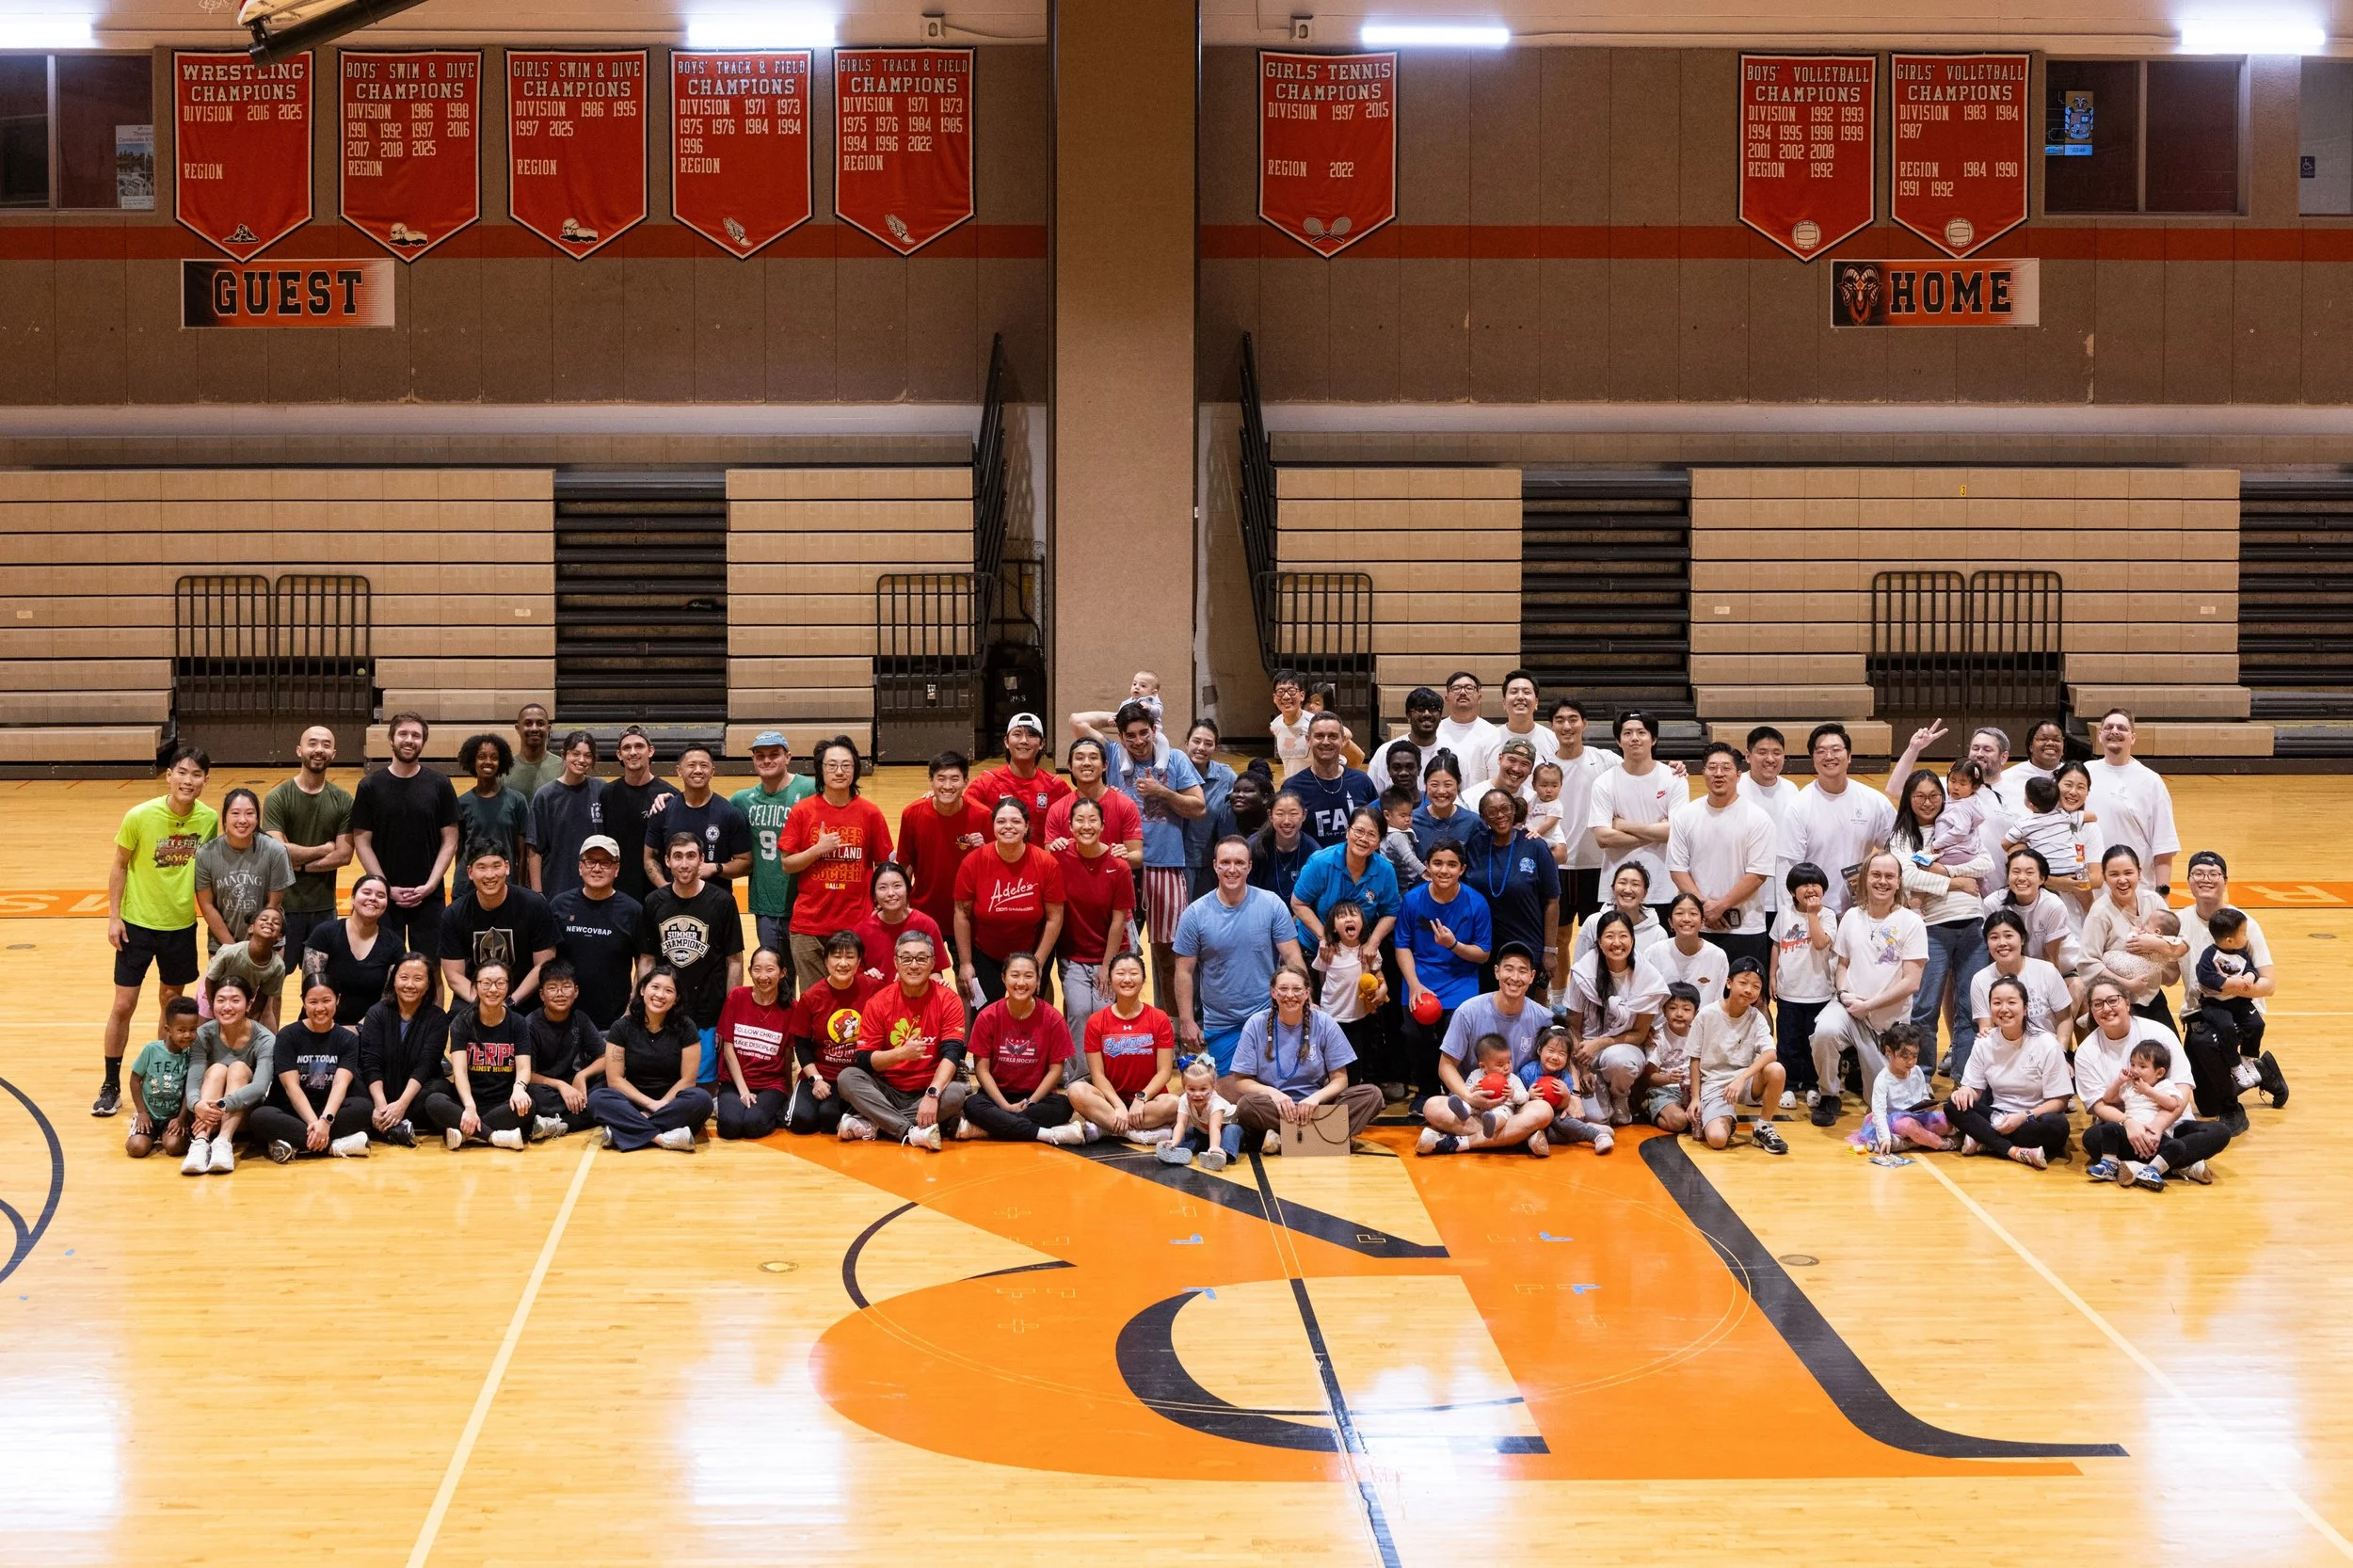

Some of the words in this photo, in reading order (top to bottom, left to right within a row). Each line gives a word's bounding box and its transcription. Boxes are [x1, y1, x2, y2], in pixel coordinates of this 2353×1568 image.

[389, 64, 420, 79] SWIM
[429, 63, 436, 78] &
[447, 63, 474, 78] DIVE
[560, 62, 590, 78] SWIM
[597, 63, 604, 78] &
[612, 61, 640, 78] DIVE
[717, 62, 751, 74] TRACK
[759, 61, 766, 74] &
[775, 61, 805, 74] FIELD
[883, 60, 916, 72] TRACK
[924, 59, 930, 71] &
[938, 59, 967, 72] FIELD
[1328, 63, 1391, 80] TENNIS
[1946, 65, 2023, 81] VOLLEYBALL
[1794, 67, 1869, 82] VOLLEYBALL
[192, 84, 296, 102] CHAMPIONS
[357, 83, 464, 99] CHAMPIONS
[524, 81, 631, 97] CHAMPIONS
[688, 79, 795, 95] CHAMPIONS
[851, 77, 957, 93] CHAMPIONS
[1276, 83, 1381, 101] CHAMPIONS
[1908, 85, 2013, 101] CHAMPIONS
[1755, 86, 1860, 102] CHAMPIONS
[184, 106, 233, 121] DIVISION
[248, 105, 269, 121] 2016
[278, 104, 302, 120] 2025
[348, 103, 391, 119] DIVISION
[411, 103, 433, 118] 1986
[447, 103, 469, 118] 1988
[516, 101, 566, 117] DIVISION
[581, 102, 604, 117] 1986
[613, 101, 636, 117] 1995
[680, 99, 730, 115] DIVISION
[745, 99, 765, 115] 1971
[777, 99, 800, 114] 1973
[843, 97, 893, 112] DIVISION
[908, 97, 928, 112] 1971
[941, 98, 962, 113] 1973
[1268, 102, 1317, 120] DIVISION
[1332, 105, 1355, 120] 1997
[1366, 102, 1389, 118] 2015
[1900, 105, 1949, 121] DIVISION
[1964, 105, 1986, 120] 1983
[1996, 106, 2019, 121] 1984
[1748, 106, 1795, 121] DIVISION
[1811, 107, 1833, 122] 1992
[1841, 107, 1864, 122] 1993
[348, 123, 367, 138] 1991
[381, 123, 402, 139] 1992
[412, 122, 433, 138] 1997
[447, 122, 469, 137] 2016
[516, 121, 539, 136] 1997
[550, 121, 573, 136] 2025
[680, 119, 703, 134] 1975
[712, 119, 735, 134] 1976
[745, 119, 768, 134] 1984
[778, 119, 801, 134] 1994
[843, 117, 866, 132] 1975
[876, 117, 898, 132] 1976
[909, 117, 931, 132] 1984
[941, 117, 962, 133] 1985
[1748, 124, 1771, 139] 1994
[1780, 125, 1802, 141] 1995
[1811, 126, 1833, 141] 1998
[1841, 126, 1863, 141] 1999
[1900, 123, 1922, 139] 1987
[348, 142, 369, 157] 2017
[381, 142, 403, 158] 2018
[412, 141, 436, 156] 2025
[680, 138, 703, 154] 1996
[843, 136, 867, 151] 1994
[876, 136, 898, 151] 1996
[908, 136, 932, 151] 2022
[1748, 143, 1770, 158] 2001
[1779, 144, 1804, 159] 2002
[1810, 144, 1834, 159] 2008
[184, 163, 223, 179] REGION
[348, 161, 383, 176] REGION
[517, 160, 557, 175] REGION
[681, 158, 720, 173] REGION
[844, 155, 883, 171] REGION
[1268, 160, 1307, 177] REGION
[1330, 162, 1354, 178] 2022
[1748, 162, 1785, 177] REGION
[1811, 163, 1833, 177] 1992
[1900, 162, 1939, 177] REGION
[1963, 162, 1986, 177] 1984
[1995, 162, 2018, 177] 1990
[1899, 181, 1919, 196] 1991
[1931, 181, 1954, 197] 1992
[213, 270, 363, 316] GUEST
[1890, 270, 2013, 314] HOME
[759, 830, 777, 861] 9
[217, 874, 263, 888] DANCING
[566, 926, 612, 936] NEWCOVBAP
[667, 931, 697, 939] SUMMER
[297, 1055, 313, 1063] NOT
